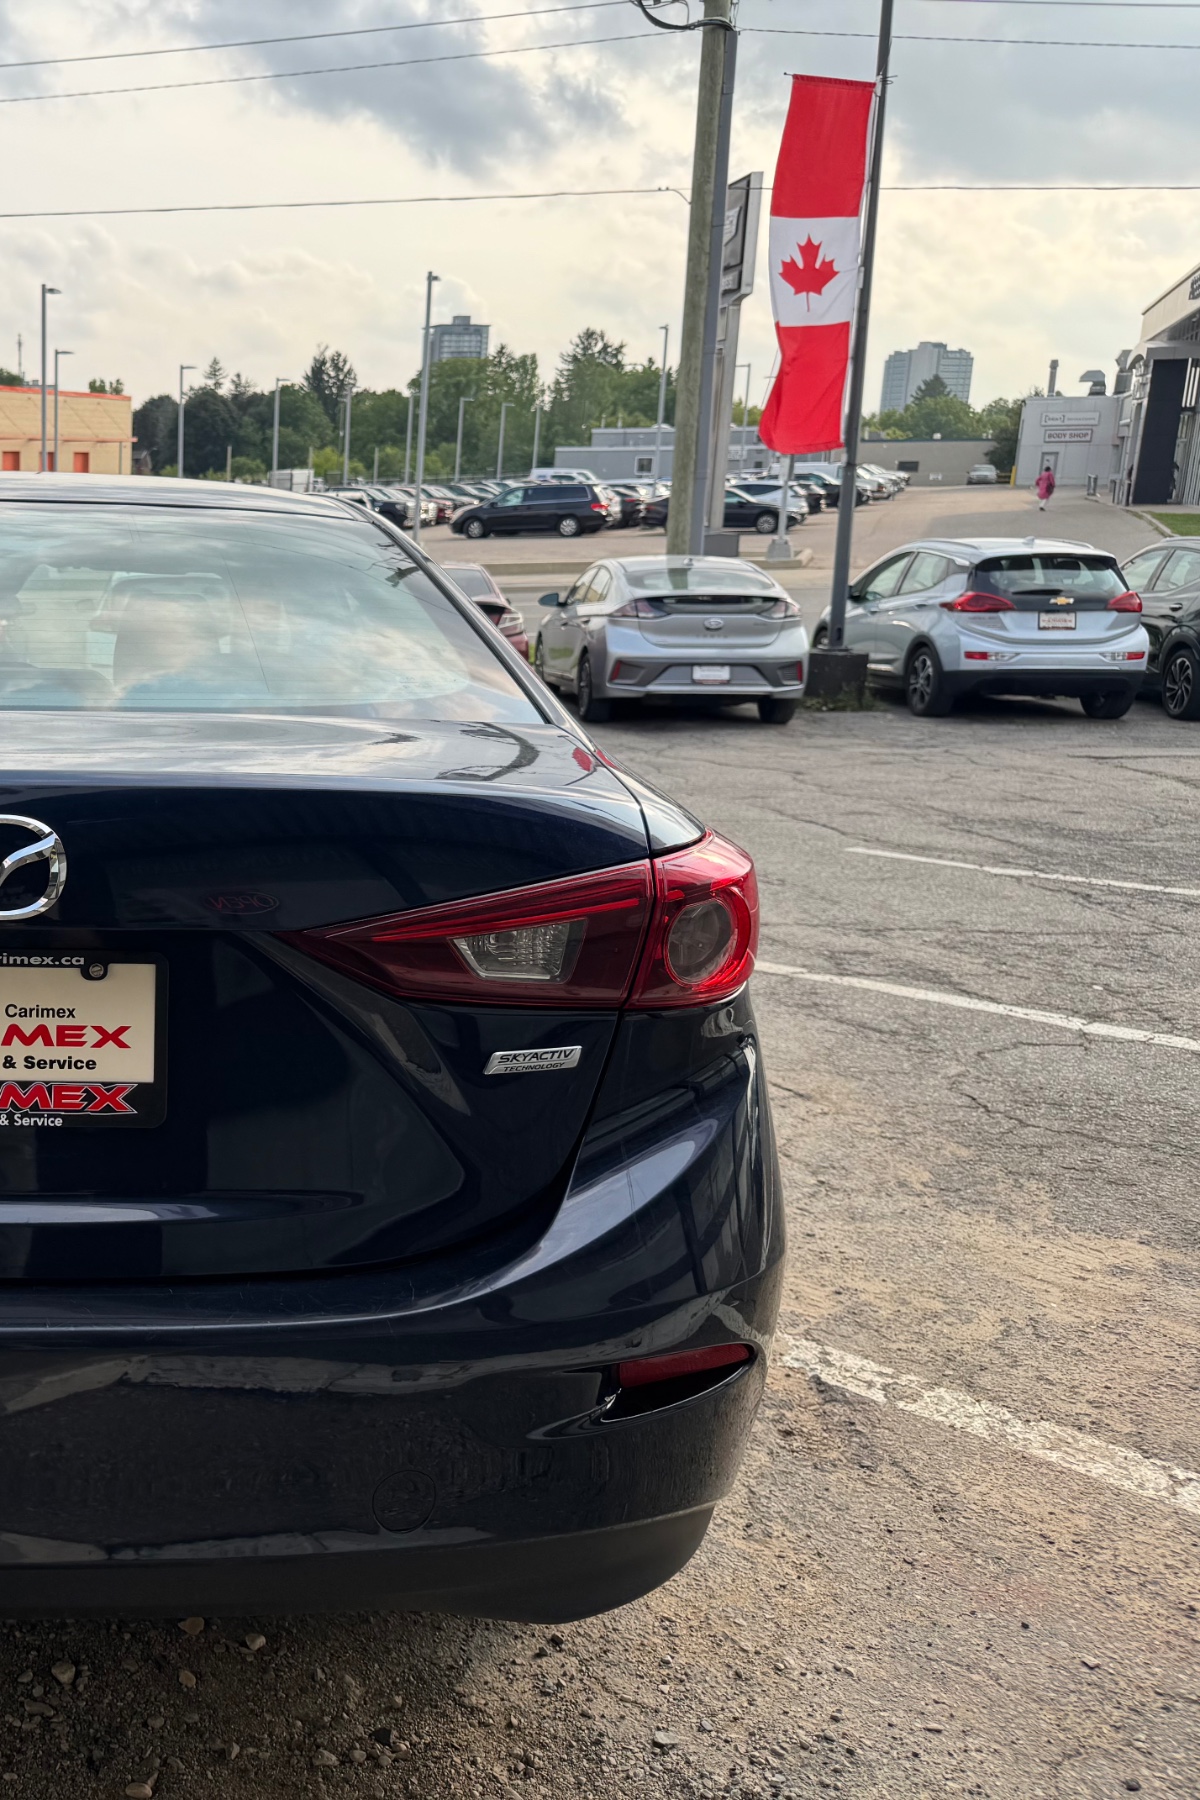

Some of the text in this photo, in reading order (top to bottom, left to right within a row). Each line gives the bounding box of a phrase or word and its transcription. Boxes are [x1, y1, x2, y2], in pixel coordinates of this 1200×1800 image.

[4, 1004, 76, 1019] Carimex
[2, 1055, 17, 1069] &
[23, 1055, 97, 1070] Service
[498, 1049, 574, 1063] SKYACTIV
[504, 1062, 565, 1072] TECHNOLOGY
[0, 1113, 9, 1126] &
[13, 1114, 63, 1127] Service
